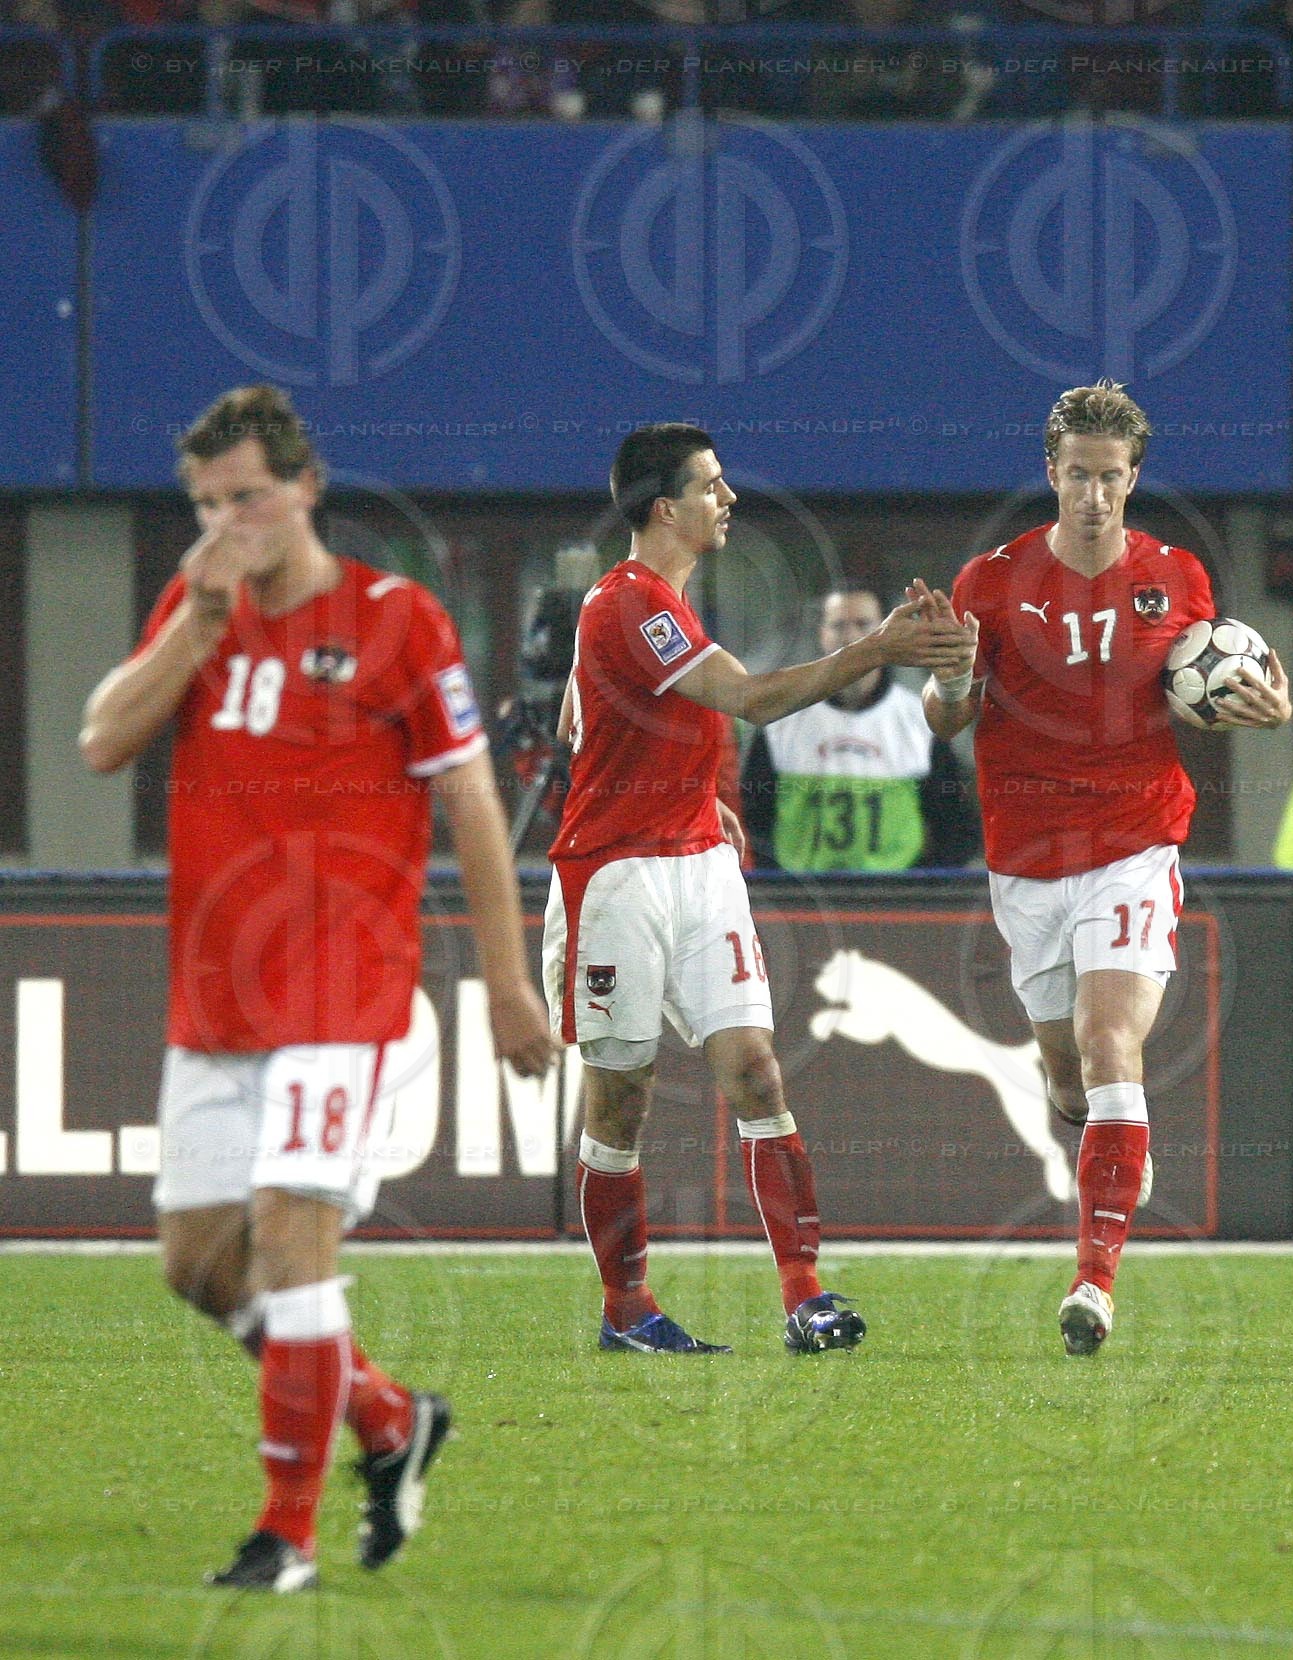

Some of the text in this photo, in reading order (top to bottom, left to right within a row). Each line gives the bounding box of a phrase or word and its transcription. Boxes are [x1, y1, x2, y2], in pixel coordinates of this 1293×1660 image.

[1062, 608, 1116, 665] 17
[211, 654, 287, 736] 18
[1110, 900, 1155, 950] 17
[283, 1083, 347, 1153] 18
